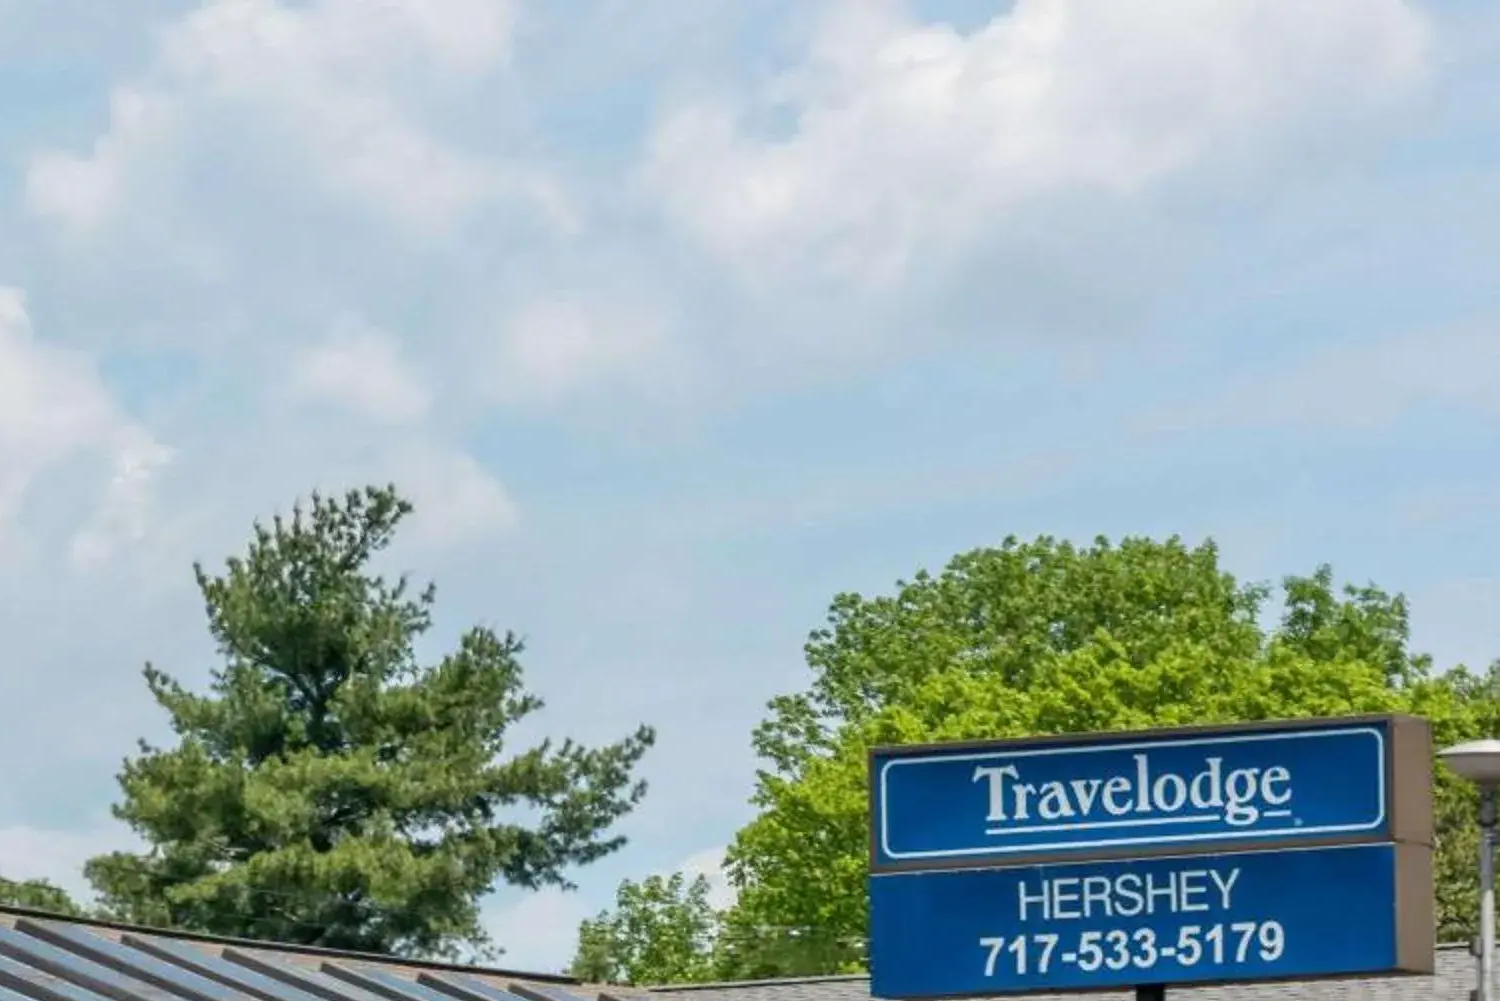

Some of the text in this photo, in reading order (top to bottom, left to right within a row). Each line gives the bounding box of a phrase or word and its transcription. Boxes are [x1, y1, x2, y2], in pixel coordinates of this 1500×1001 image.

[972, 754, 1292, 826] Travelodge
[1018, 867, 1240, 921] HERSHEY
[979, 920, 1285, 977] 717-533-5179
